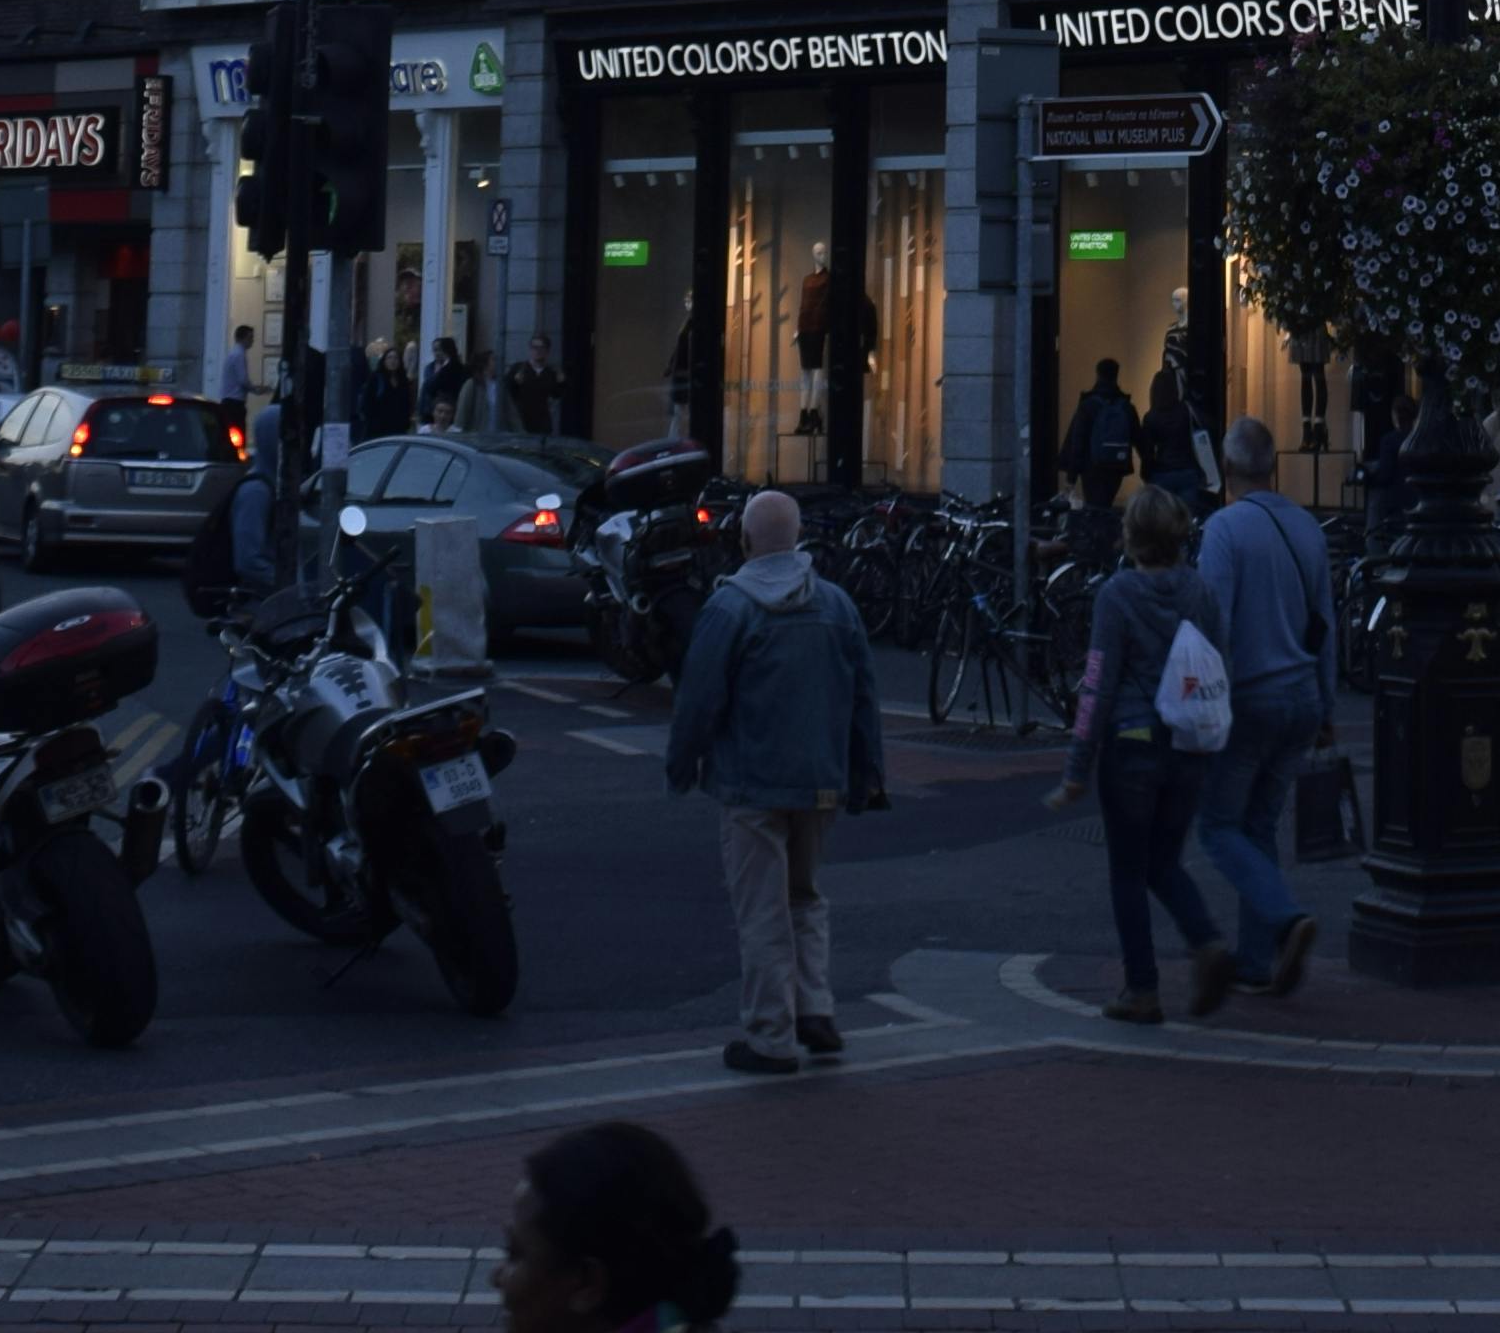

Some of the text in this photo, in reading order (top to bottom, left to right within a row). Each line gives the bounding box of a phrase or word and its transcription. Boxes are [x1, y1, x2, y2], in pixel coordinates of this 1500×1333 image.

[1039, 7, 1150, 48] UNITED
[578, 44, 665, 81] UNITED
[667, 40, 766, 77] COLORS
[768, 36, 804, 71] OF
[140, 90, 163, 188] FRIDAYS
[1046, 126, 1185, 146] NATIONAL WAX MUSEUM PLUS
